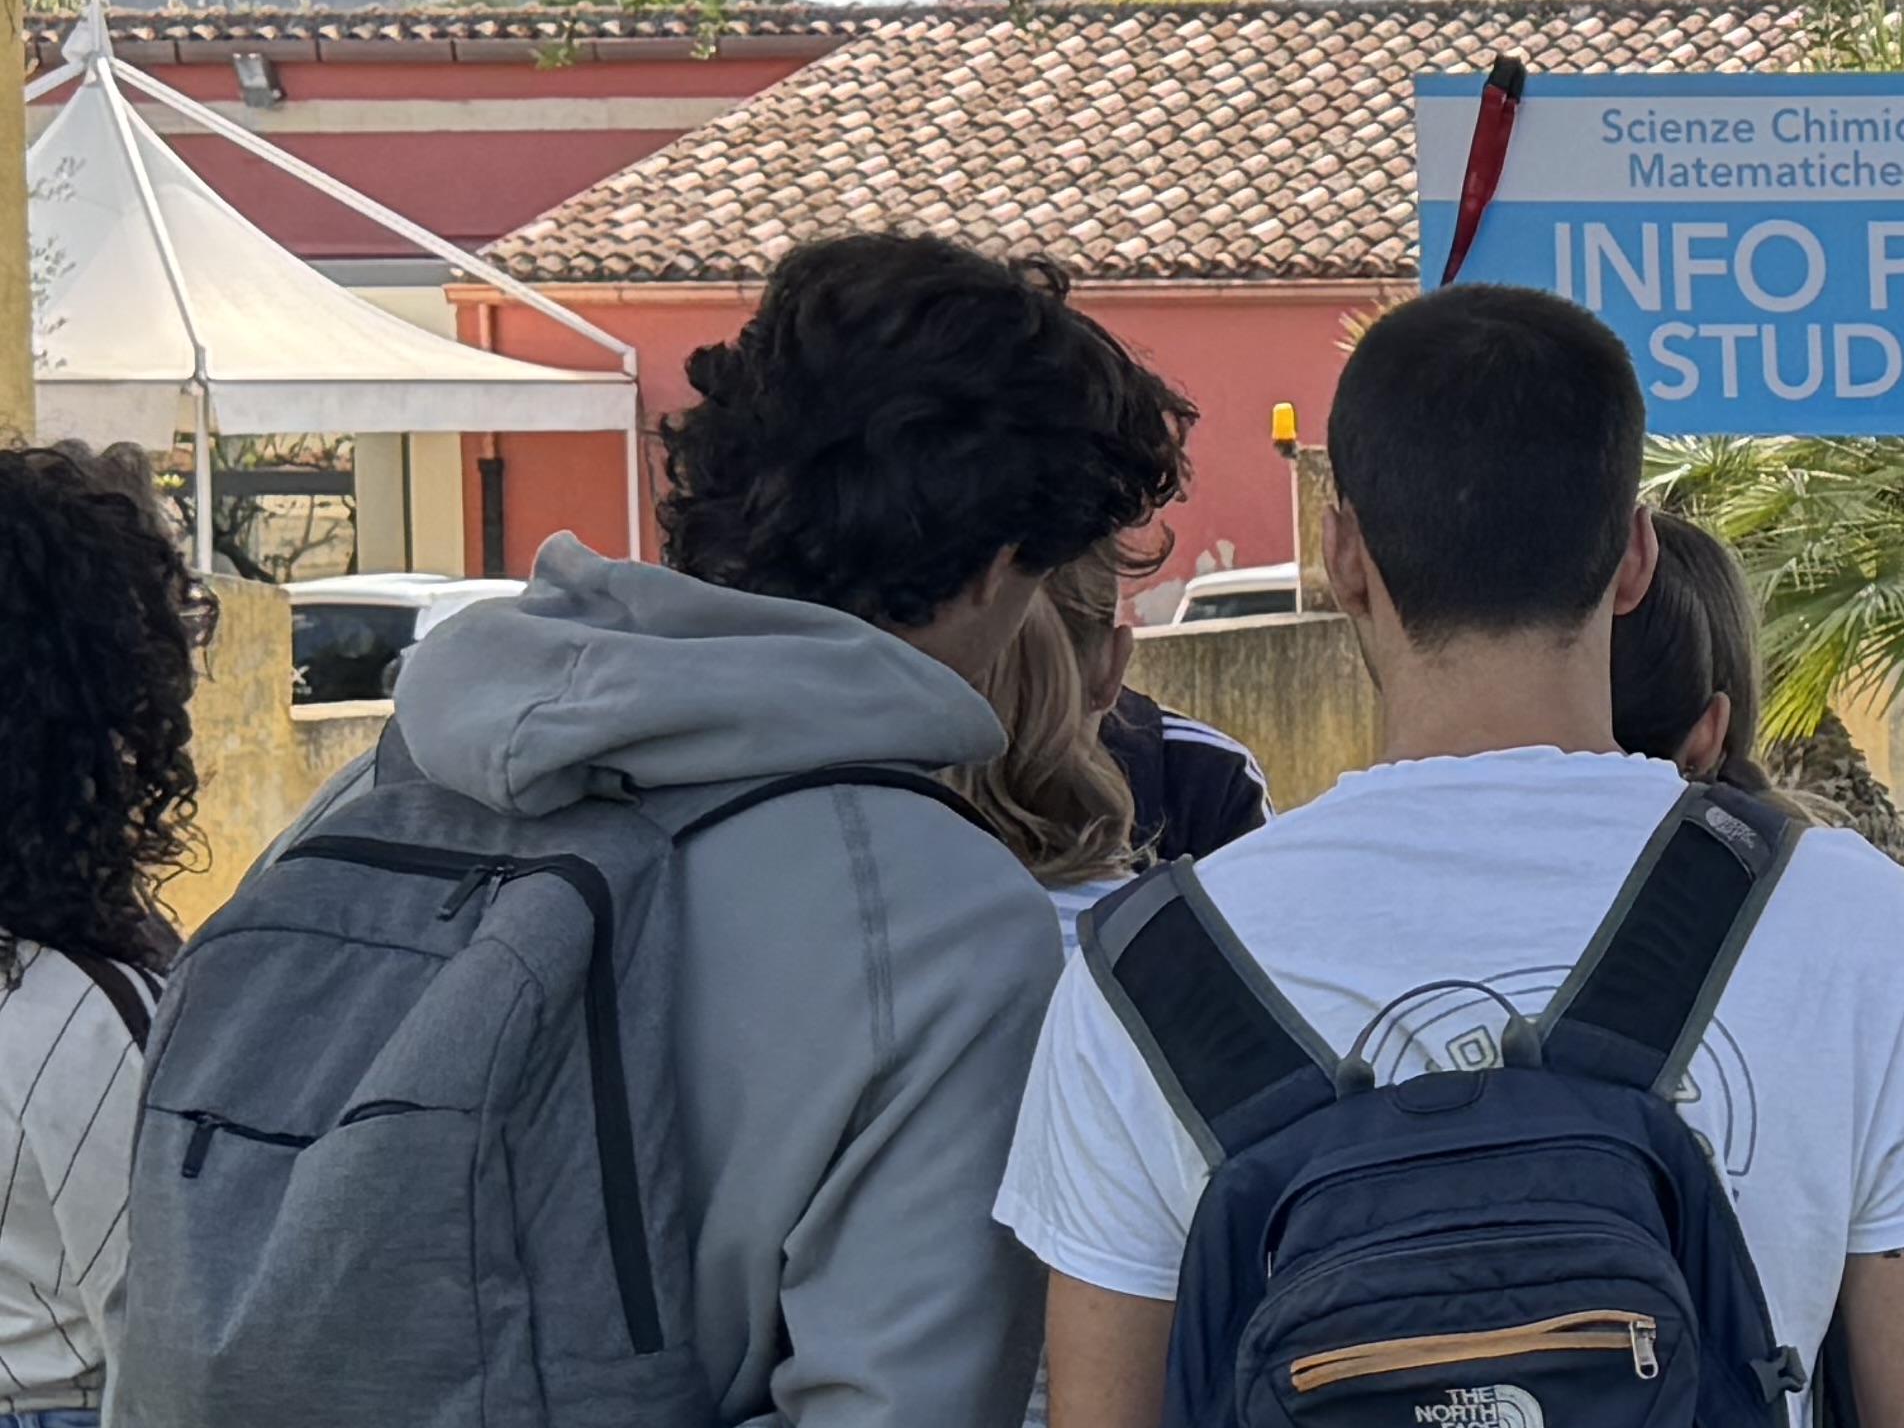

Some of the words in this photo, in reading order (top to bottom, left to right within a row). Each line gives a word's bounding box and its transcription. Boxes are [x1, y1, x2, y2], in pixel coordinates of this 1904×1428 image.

[1601, 108, 1755, 146] Scienze
[1628, 152, 1903, 189] Matematiche
[1555, 220, 1827, 313] INFO
[1414, 1403, 1498, 1424] NORTH
[1446, 1386, 1496, 1406] THE
